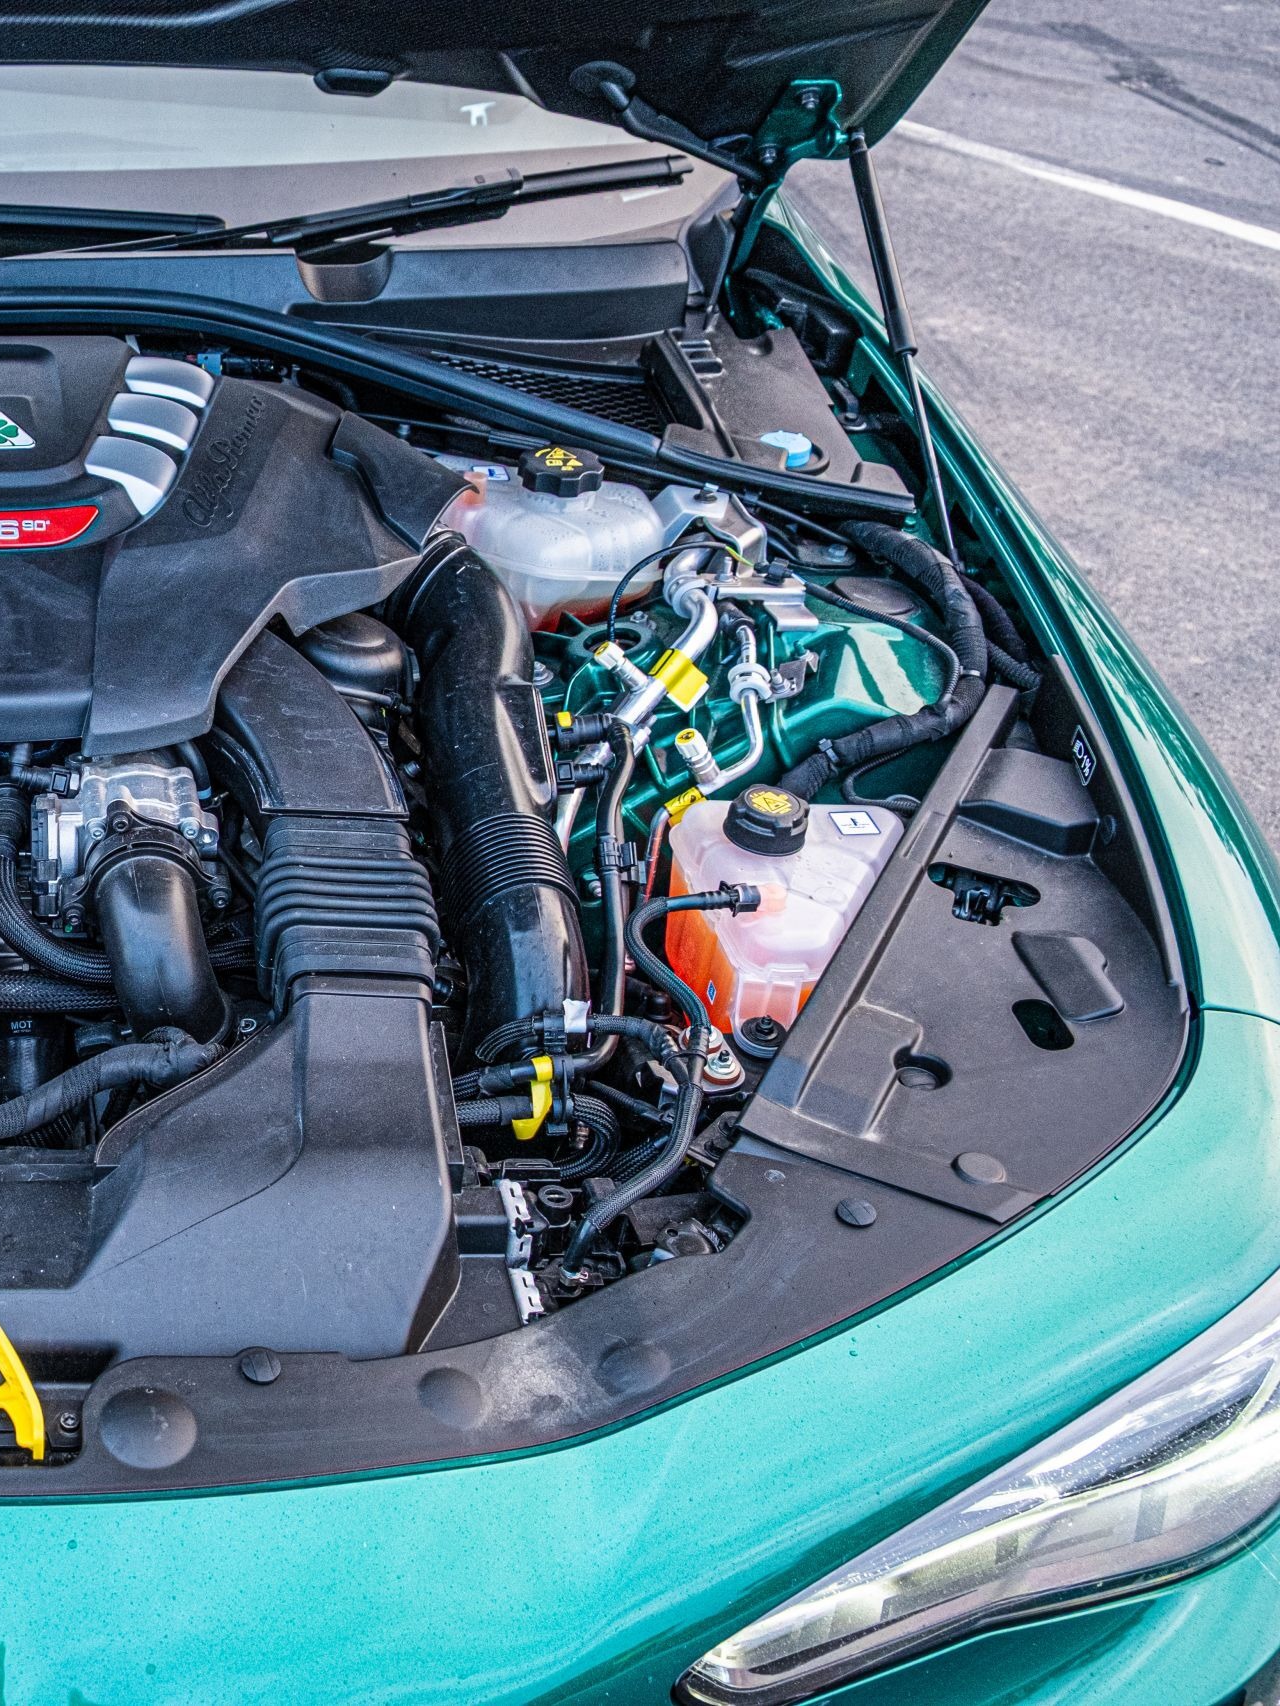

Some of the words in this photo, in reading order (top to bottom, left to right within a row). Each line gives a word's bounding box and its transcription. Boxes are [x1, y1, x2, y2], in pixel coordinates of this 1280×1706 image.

[178, 468, 234, 528] Alfa
[206, 395, 265, 470] Romeo
[10, 1020, 33, 1030] MOT
